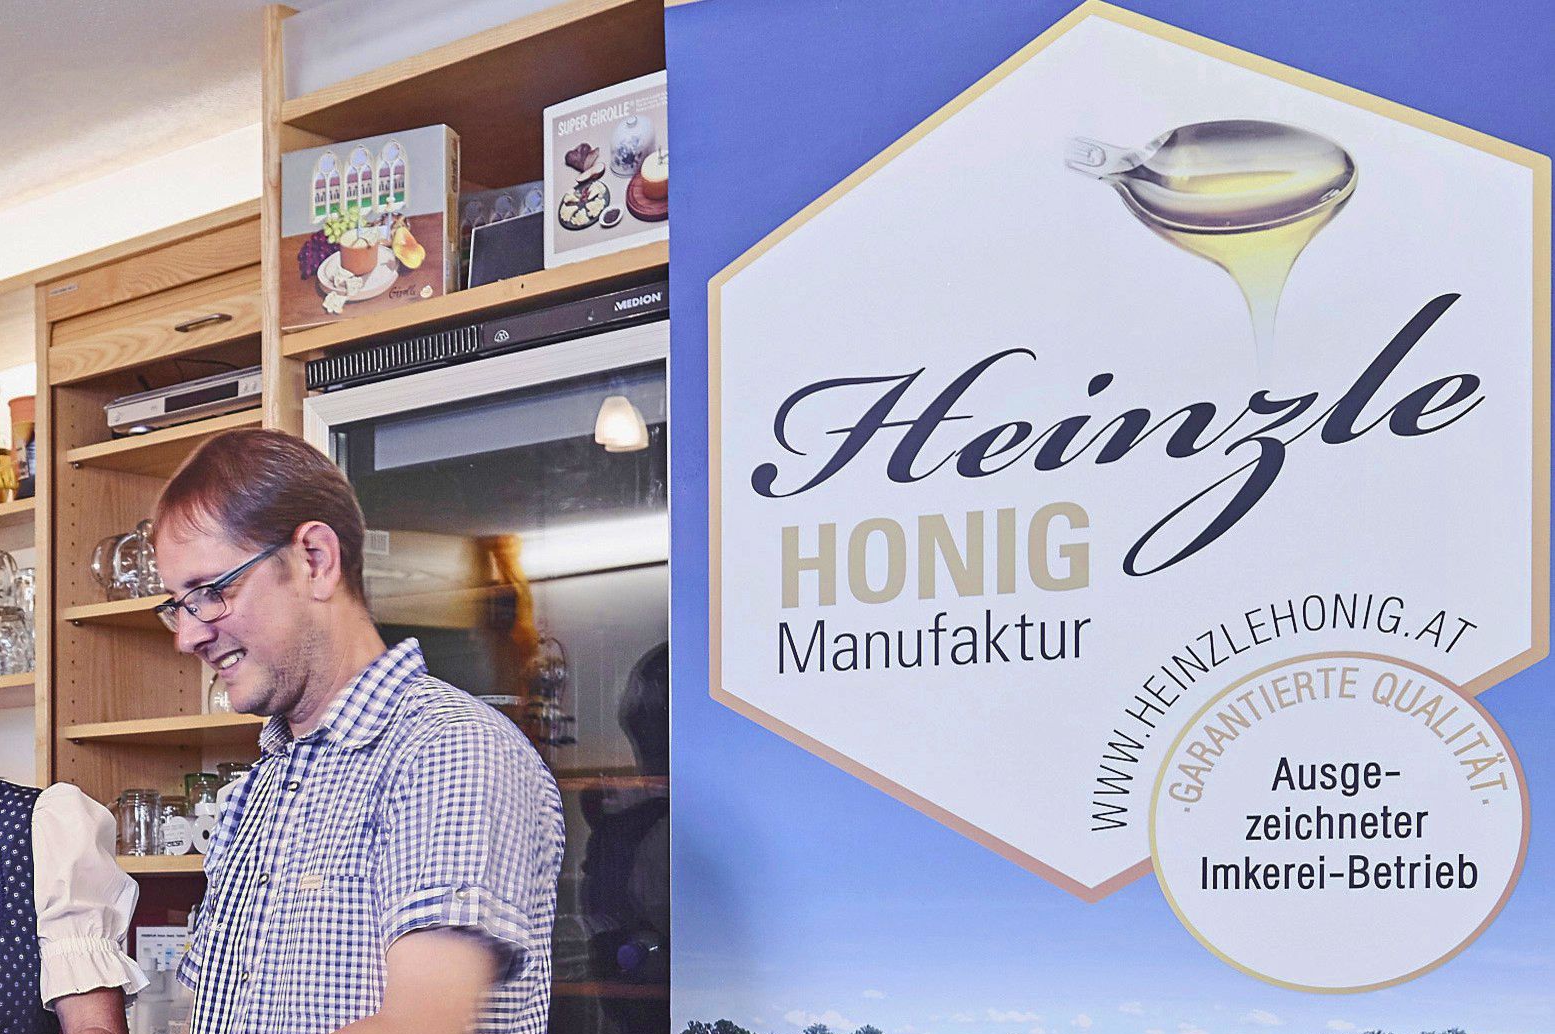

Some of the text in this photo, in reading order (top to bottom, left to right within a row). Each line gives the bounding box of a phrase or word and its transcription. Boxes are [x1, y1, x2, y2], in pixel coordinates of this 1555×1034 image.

[557, 114, 588, 136] SUPER
[614, 292, 662, 311] MEDION
[751, 293, 1486, 577] Heinzle
[780, 501, 1091, 609] HONIG
[777, 609, 1091, 675] Manufaktur
[1090, 593, 1478, 833] WWW.HEINZLEHONIG.AT
[1270, 756, 1402, 797] Ausge-
[1244, 806, 1429, 841] zeichneter
[1200, 853, 1479, 890] Imkerei-Betrieb
